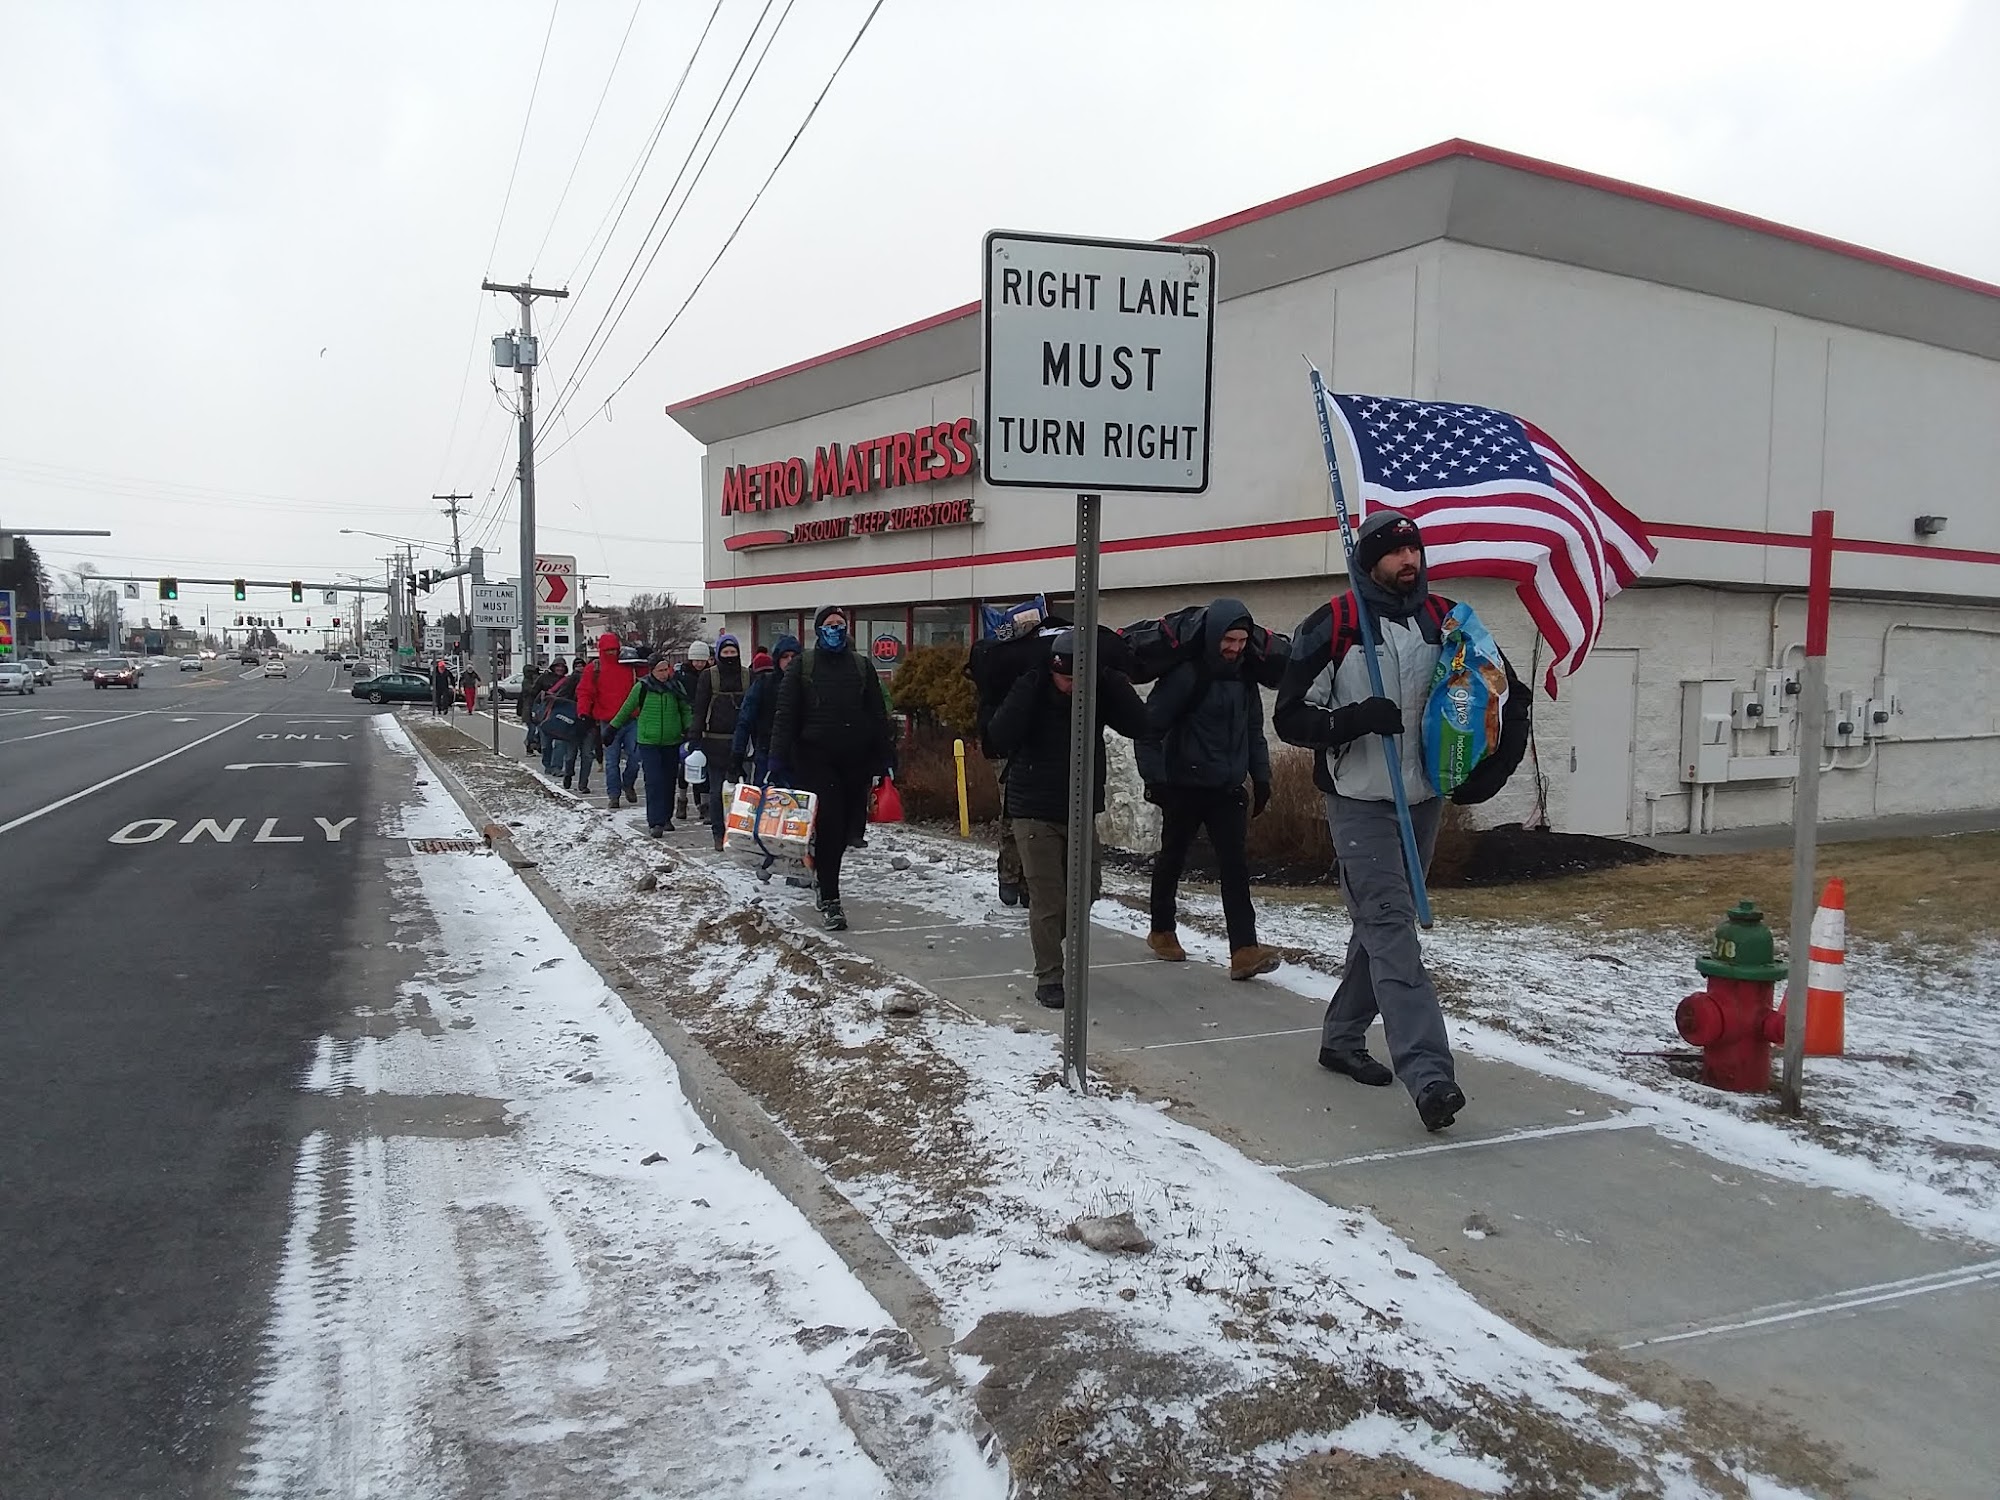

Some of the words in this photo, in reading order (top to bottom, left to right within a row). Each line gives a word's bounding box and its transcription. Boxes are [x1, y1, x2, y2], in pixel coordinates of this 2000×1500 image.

[1003, 268, 1101, 311] RIGHT
[1119, 277, 1200, 318] LANE
[1043, 341, 1161, 391] MUST
[999, 417, 1085, 456] TURN
[1104, 422, 1198, 461] RIGHT
[721, 457, 806, 516] METRO
[811, 417, 976, 501] MATTRESS
[1312, 381, 1331, 444] UNITED
[1336, 501, 1353, 557] STAND
[793, 517, 849, 543] DISCOUNT
[851, 511, 889, 535] SLEEP
[887, 499, 973, 530] SUPERSTORE
[475, 590, 493, 598] LEFT
[496, 590, 515, 599] LANE
[482, 602, 508, 611] MUST
[475, 615, 494, 623] TURN
[496, 615, 515, 624] LEFT
[426, 639, 443, 648] 35
[873, 641, 899, 657] OPEN
[256, 733, 355, 741] ONLY
[1456, 735, 1466, 761] Indoor
[107, 817, 358, 844] ONLY
